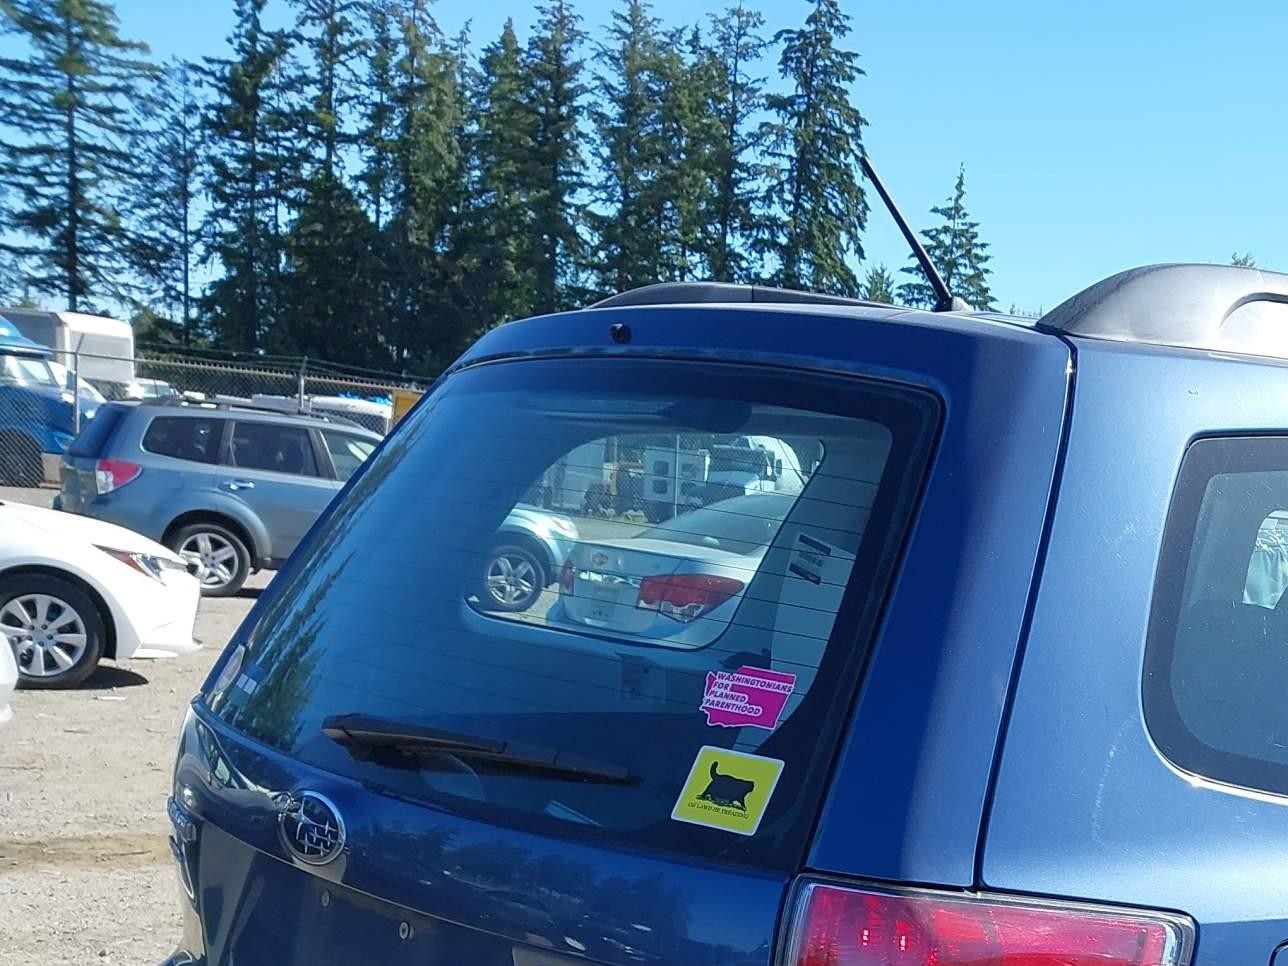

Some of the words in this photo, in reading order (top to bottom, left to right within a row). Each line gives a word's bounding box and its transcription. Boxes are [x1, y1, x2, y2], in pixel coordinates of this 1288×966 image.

[712, 681, 731, 691] FOR
[717, 672, 793, 693] WASHINGTONIANS
[708, 690, 747, 703] PLANNED
[703, 698, 761, 715] PARENTHOOD
